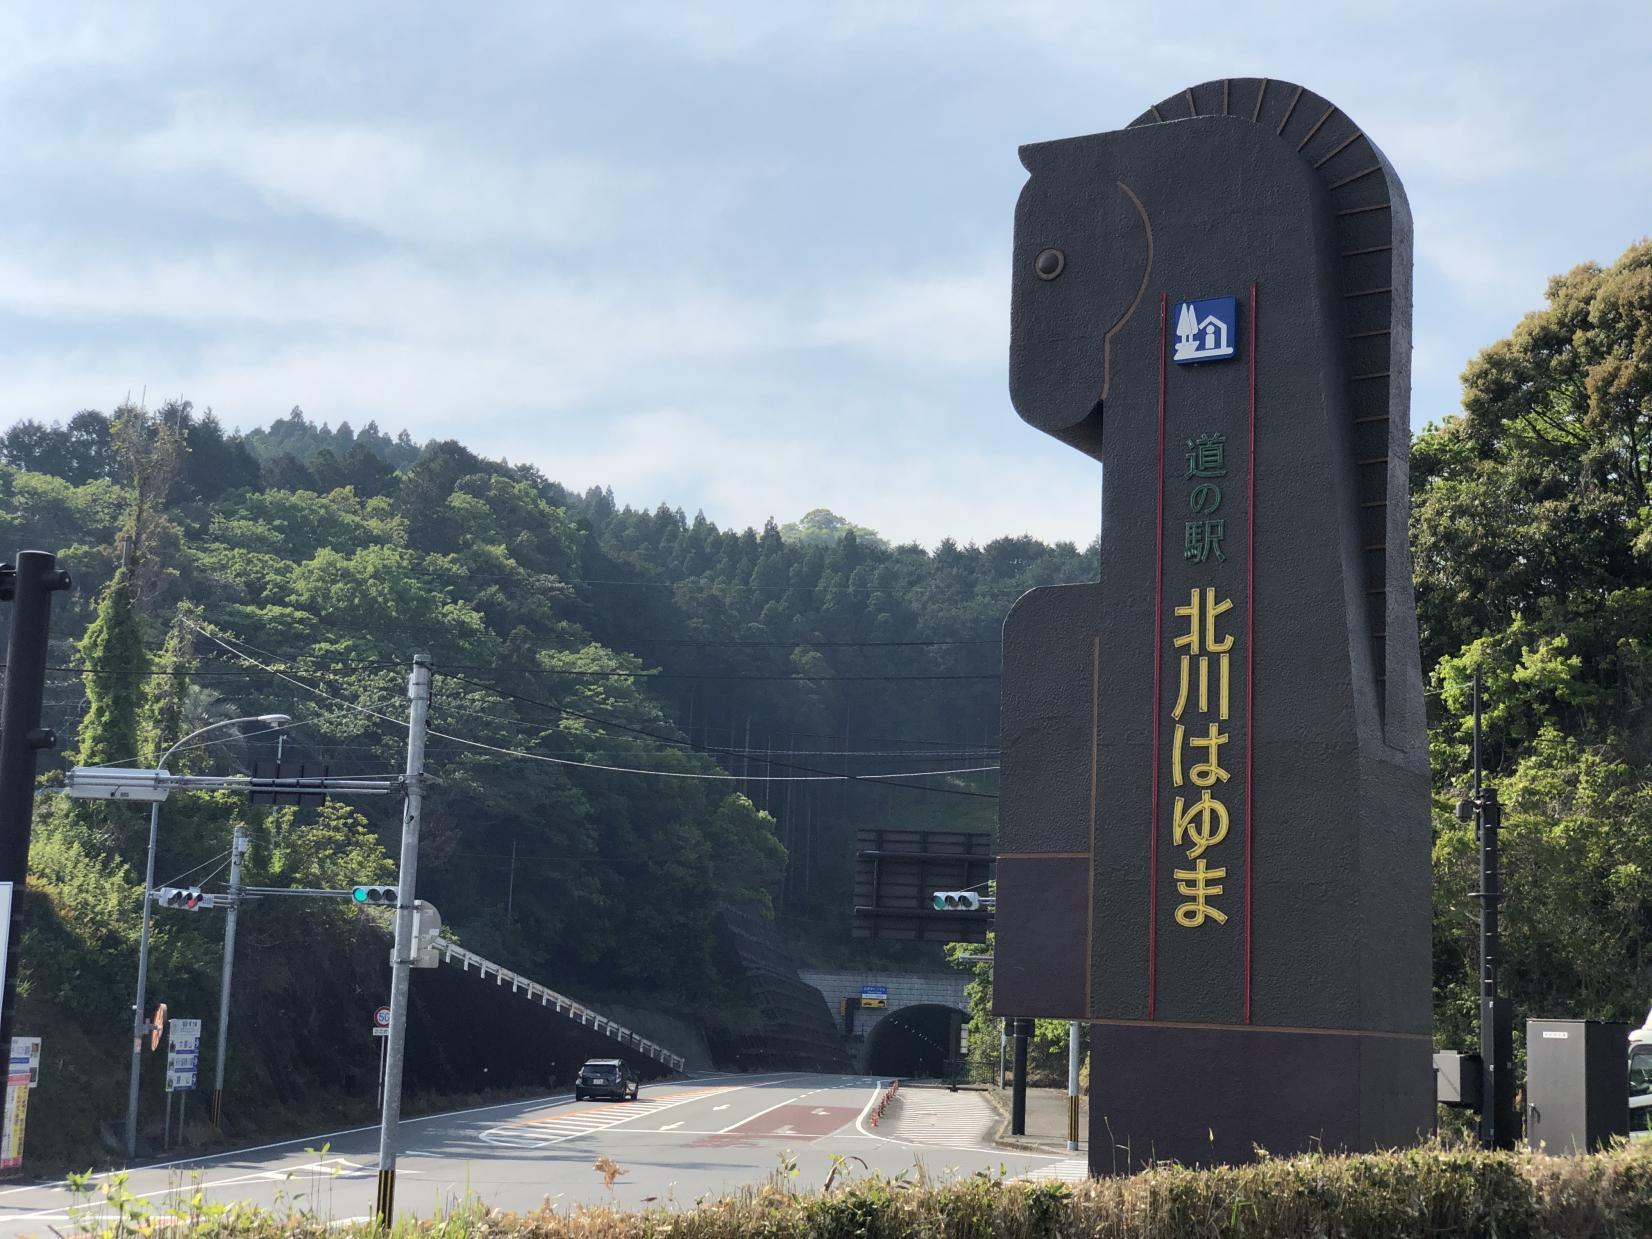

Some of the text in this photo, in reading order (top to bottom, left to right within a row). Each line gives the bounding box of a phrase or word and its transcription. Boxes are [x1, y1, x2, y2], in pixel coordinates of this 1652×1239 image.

[1184, 432, 1228, 564] 道の駅
[1171, 587, 1235, 928] 北川はゆま
